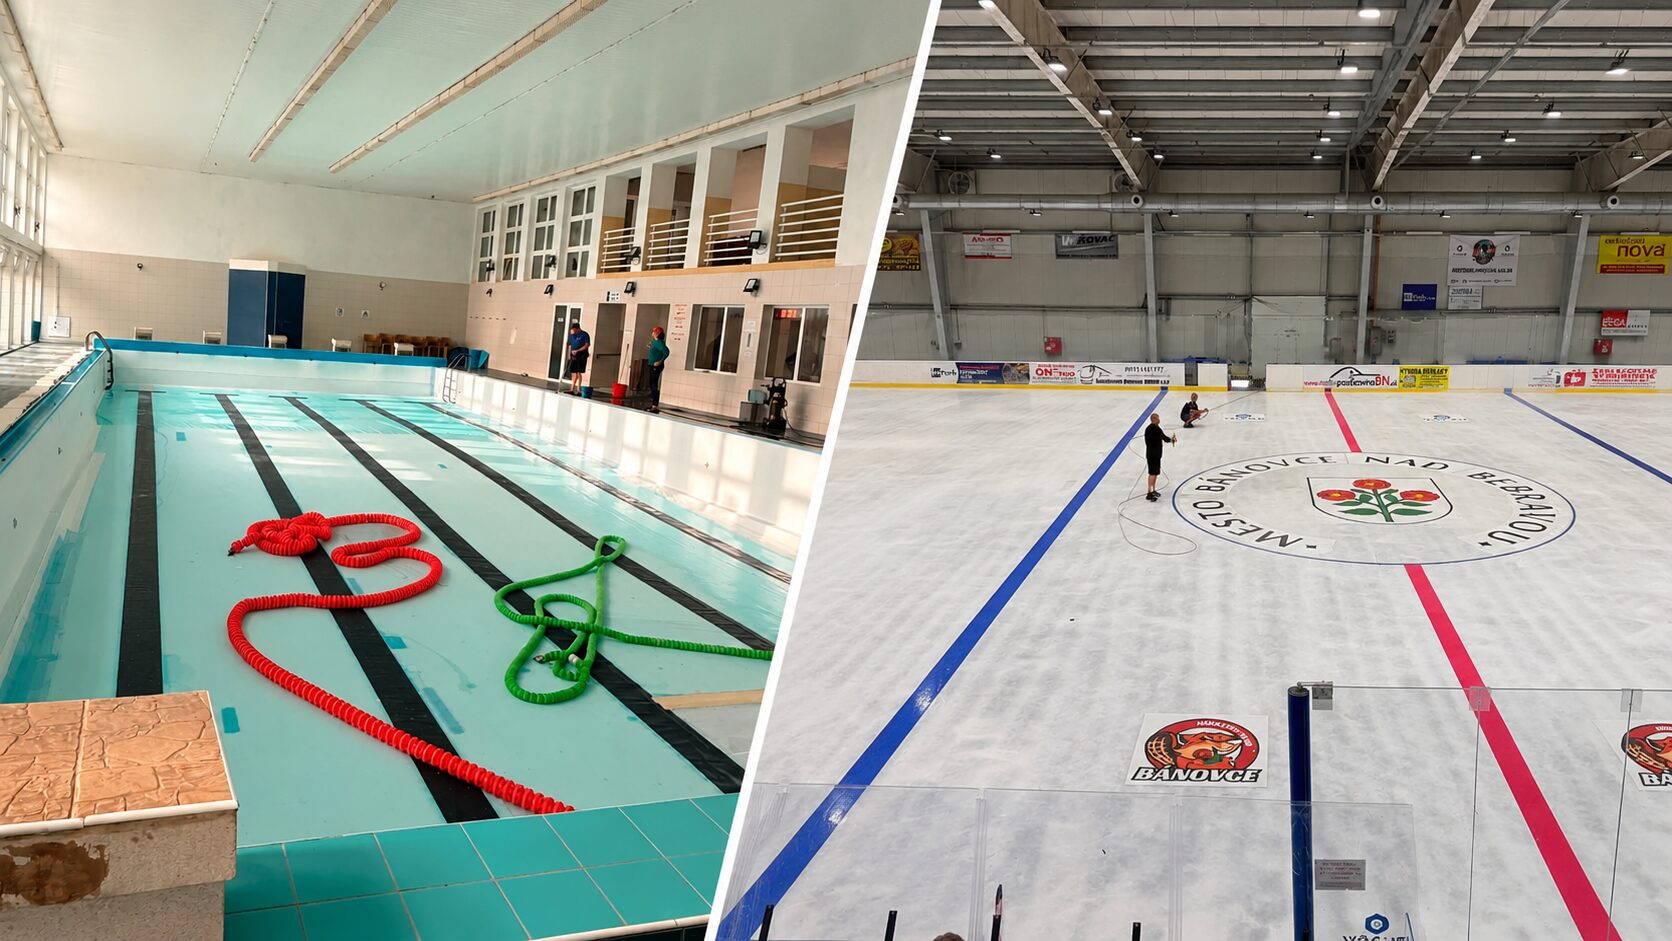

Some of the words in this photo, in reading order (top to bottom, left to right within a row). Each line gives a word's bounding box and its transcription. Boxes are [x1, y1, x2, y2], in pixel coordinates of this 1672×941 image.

[1195, 455, 1337, 492] BÁNOVCE
[1365, 456, 1449, 470] NAD
[1193, 500, 1303, 548] MESTO
[1467, 472, 1556, 545] BEBRAVOU
